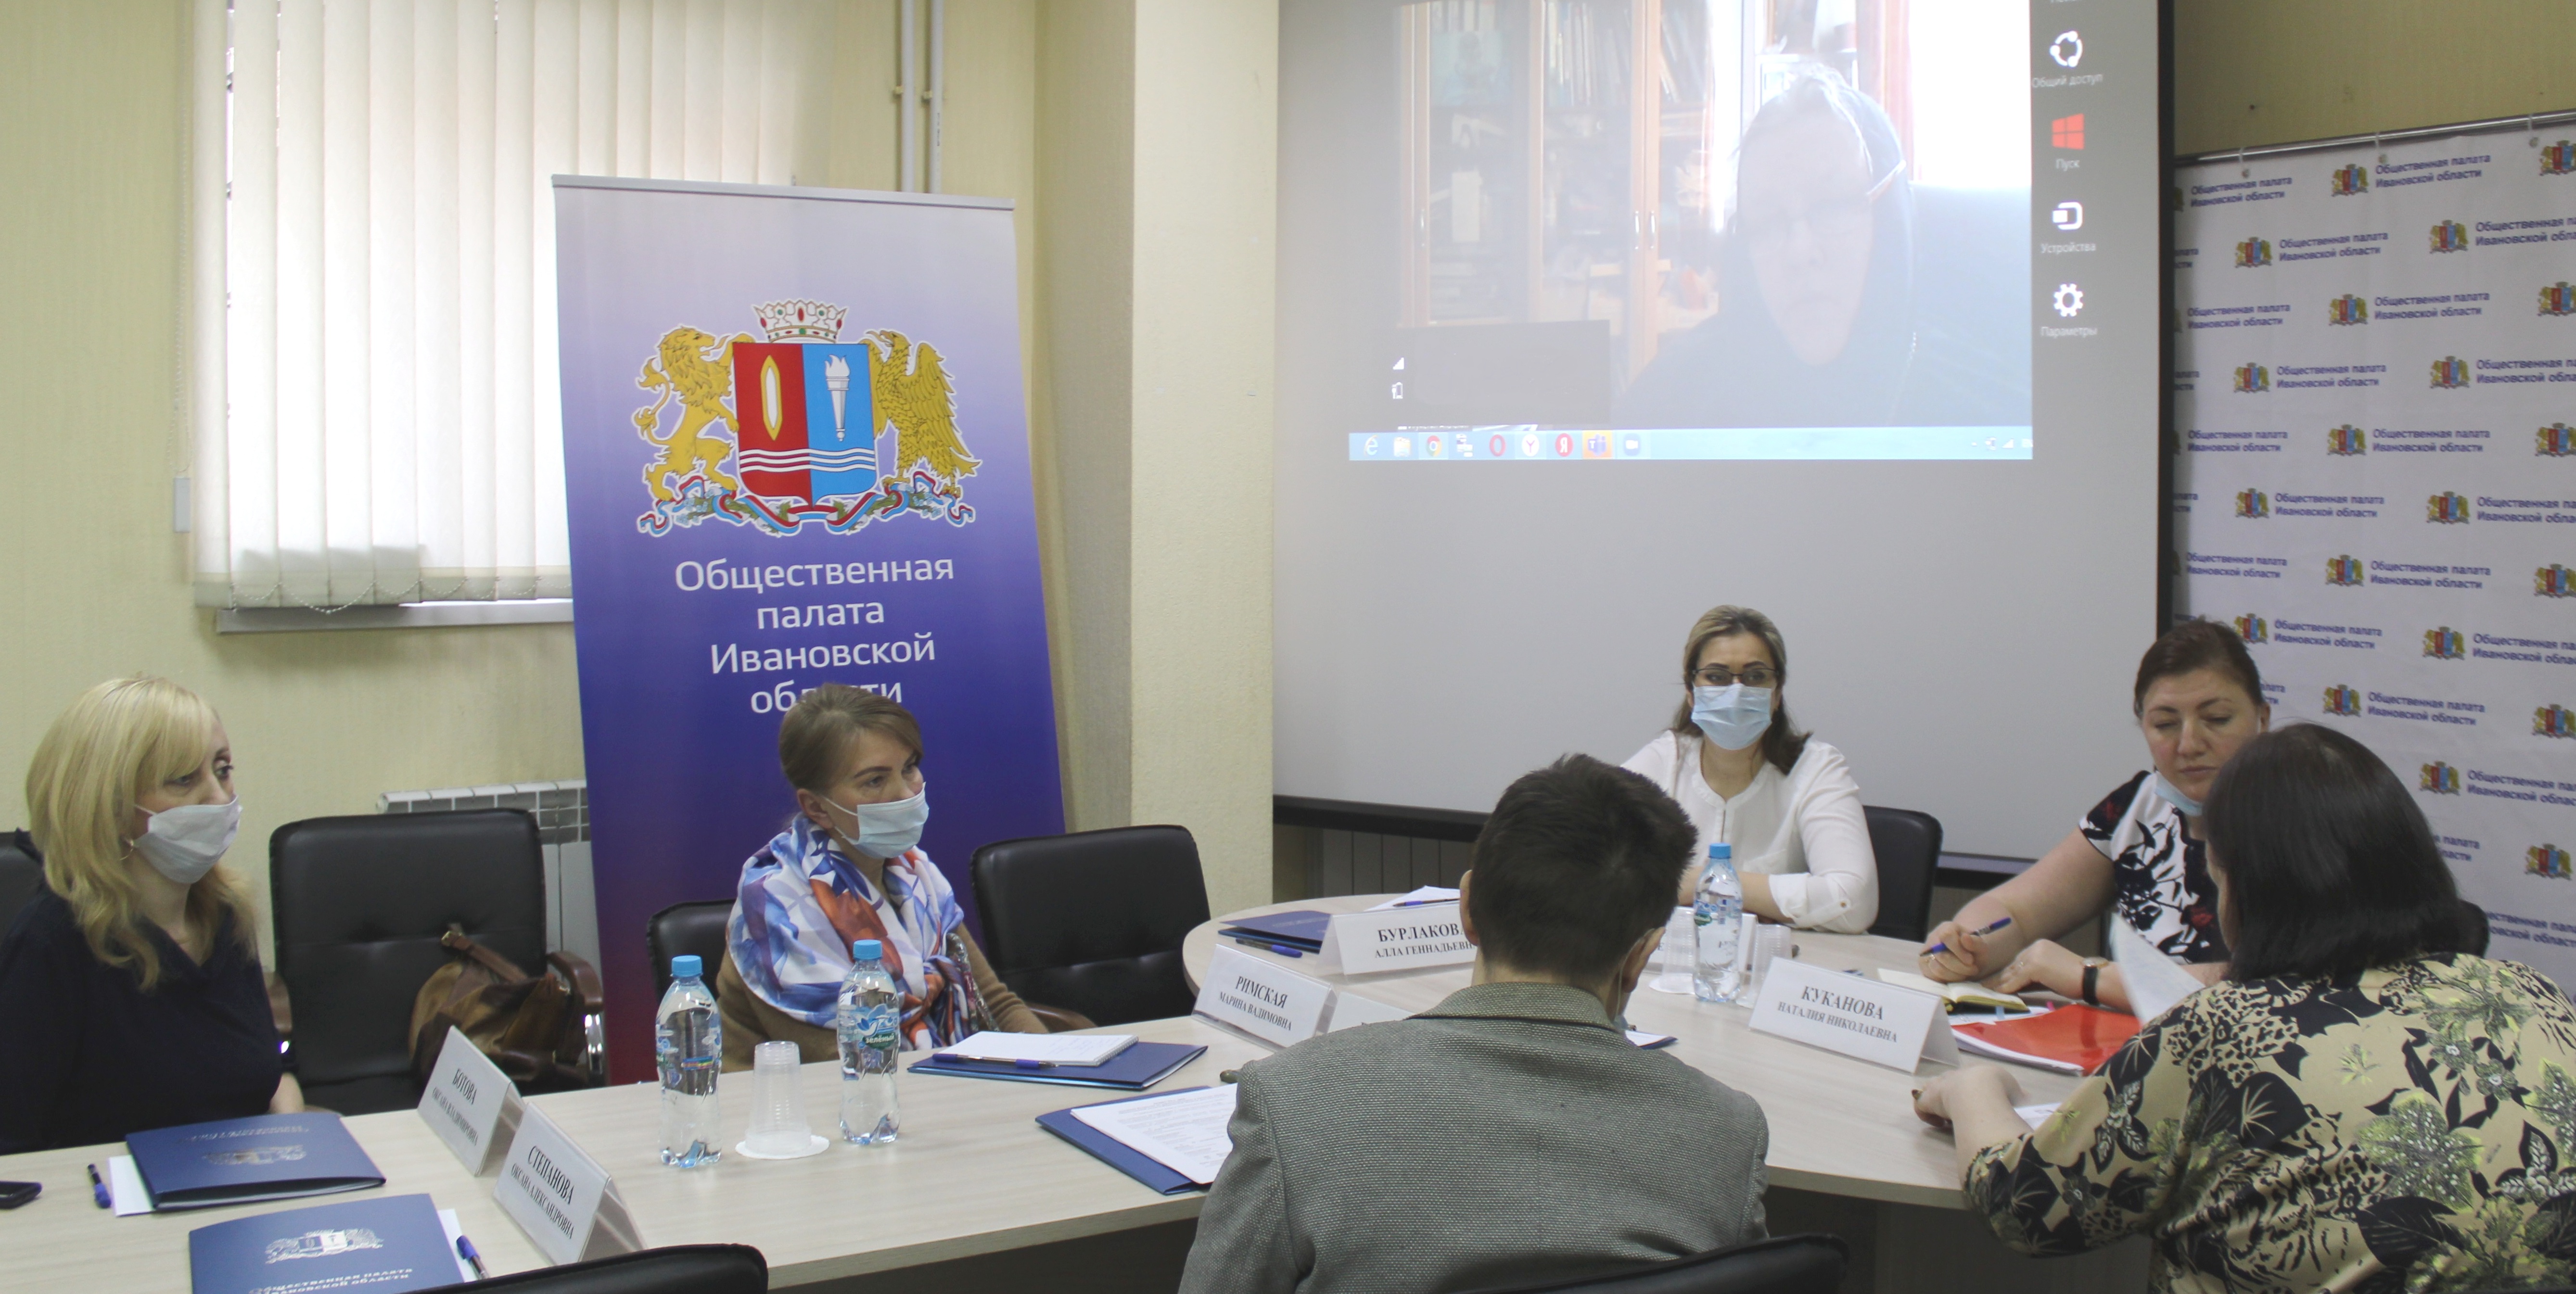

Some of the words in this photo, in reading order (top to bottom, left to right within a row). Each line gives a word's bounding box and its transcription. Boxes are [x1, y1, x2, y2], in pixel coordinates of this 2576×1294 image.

[2033, 76, 2067, 88] Общий
[2069, 74, 2103, 86] доступ
[2056, 158, 2080, 171] Пуск
[2376, 159, 2448, 174] Общественная
[2451, 155, 2490, 165] палата
[2376, 173, 2434, 188] Ивановской
[2436, 170, 2482, 181] области
[2191, 180, 2257, 195] Общественная
[2259, 178, 2292, 187] палата
[2191, 192, 2243, 206] Ивановской
[2245, 191, 2284, 201] области
[2476, 219, 2564, 232] Общественная
[2280, 236, 2350, 248] Общественная
[2353, 233, 2388, 242] палата
[2475, 232, 2548, 246] Ивановской
[2040, 242, 2096, 254] Устройства
[2280, 249, 2336, 261] Ивановской
[2339, 247, 2381, 256] области
[2375, 295, 2451, 306] Общественная
[2454, 293, 2489, 302] палата
[2189, 307, 2254, 316] Общественная
[2375, 308, 2438, 319] Ивановской
[2441, 307, 2481, 317] области
[2189, 318, 2241, 328] Ивановской
[2243, 317, 2283, 326] области
[2041, 326, 2097, 338] Параметры
[2277, 366, 2349, 376] Общественная
[2352, 365, 2386, 373] палата
[2476, 359, 2563, 370] Общественная
[2277, 379, 2334, 388] Ивановской
[2337, 377, 2379, 387] области
[2477, 372, 2545, 383] Ивановской
[2189, 431, 2253, 439] Общественная
[2373, 429, 2452, 439] Общественная
[2456, 430, 2490, 439] палата
[2188, 443, 2241, 451] Ивановской
[2243, 443, 2281, 452] области
[2373, 443, 2436, 452] Ивановской
[2439, 443, 2483, 452] области
[2275, 493, 2348, 503] Общественная
[2351, 496, 2384, 505] палата
[2477, 497, 2559, 508] Общественная
[2275, 507, 2334, 516] Ивановской
[2336, 507, 2377, 518] области
[2477, 511, 2542, 522] Ивановской
[2188, 552, 2254, 563] Общественная
[2256, 558, 2287, 566] палата
[2188, 565, 2241, 576] Ивановской
[2243, 569, 2280, 578] области
[2371, 560, 2448, 573] Общественная
[2451, 566, 2490, 575] палата
[675, 558, 954, 594] Общественная
[2370, 574, 2432, 586] Ивановской
[2435, 578, 2482, 588] области
[757, 601, 884, 629] палата
[2275, 620, 2346, 634] Общественная
[2348, 627, 2382, 636] палата
[2274, 633, 2331, 646] Ивановской
[2334, 638, 2374, 648] области
[2474, 633, 2557, 648] Общественная
[711, 632, 935, 674] Ивановской
[2473, 648, 2542, 662] Ивановской
[2369, 692, 2444, 710] Общественная
[2447, 702, 2485, 712] палата
[2368, 706, 2428, 720] Ивановской
[2431, 713, 2476, 725] области
[2468, 770, 2555, 789] Общественная
[2467, 784, 2537, 801] Ивановской
[2444, 837, 2480, 849] палата
[1375, 946, 1403, 958] АЛЛА
[1405, 940, 1475, 955] ГЕННАДЬЕВН
[1235, 976, 1288, 1009] РИМСКАЯ
[1801, 986, 1883, 1020] КУКАНОВА
[1219, 991, 1247, 1011] МАРИНА
[1247, 1003, 1292, 1030] ВАДИМОВНА
[1778, 1001, 1825, 1023] НАТАЛИЯ
[1826, 1015, 1897, 1043] НИКОЛАЕВНА
[452, 1068, 477, 1105] БОТОВА
[528, 1145, 574, 1205] СТЕПАНОВА
[511, 1163, 531, 1193] ОКСАНА
[530, 1185, 574, 1239] АЛЕКСАНДРОВНА
[351, 1274, 408, 1285] ОБЛАСТИ
